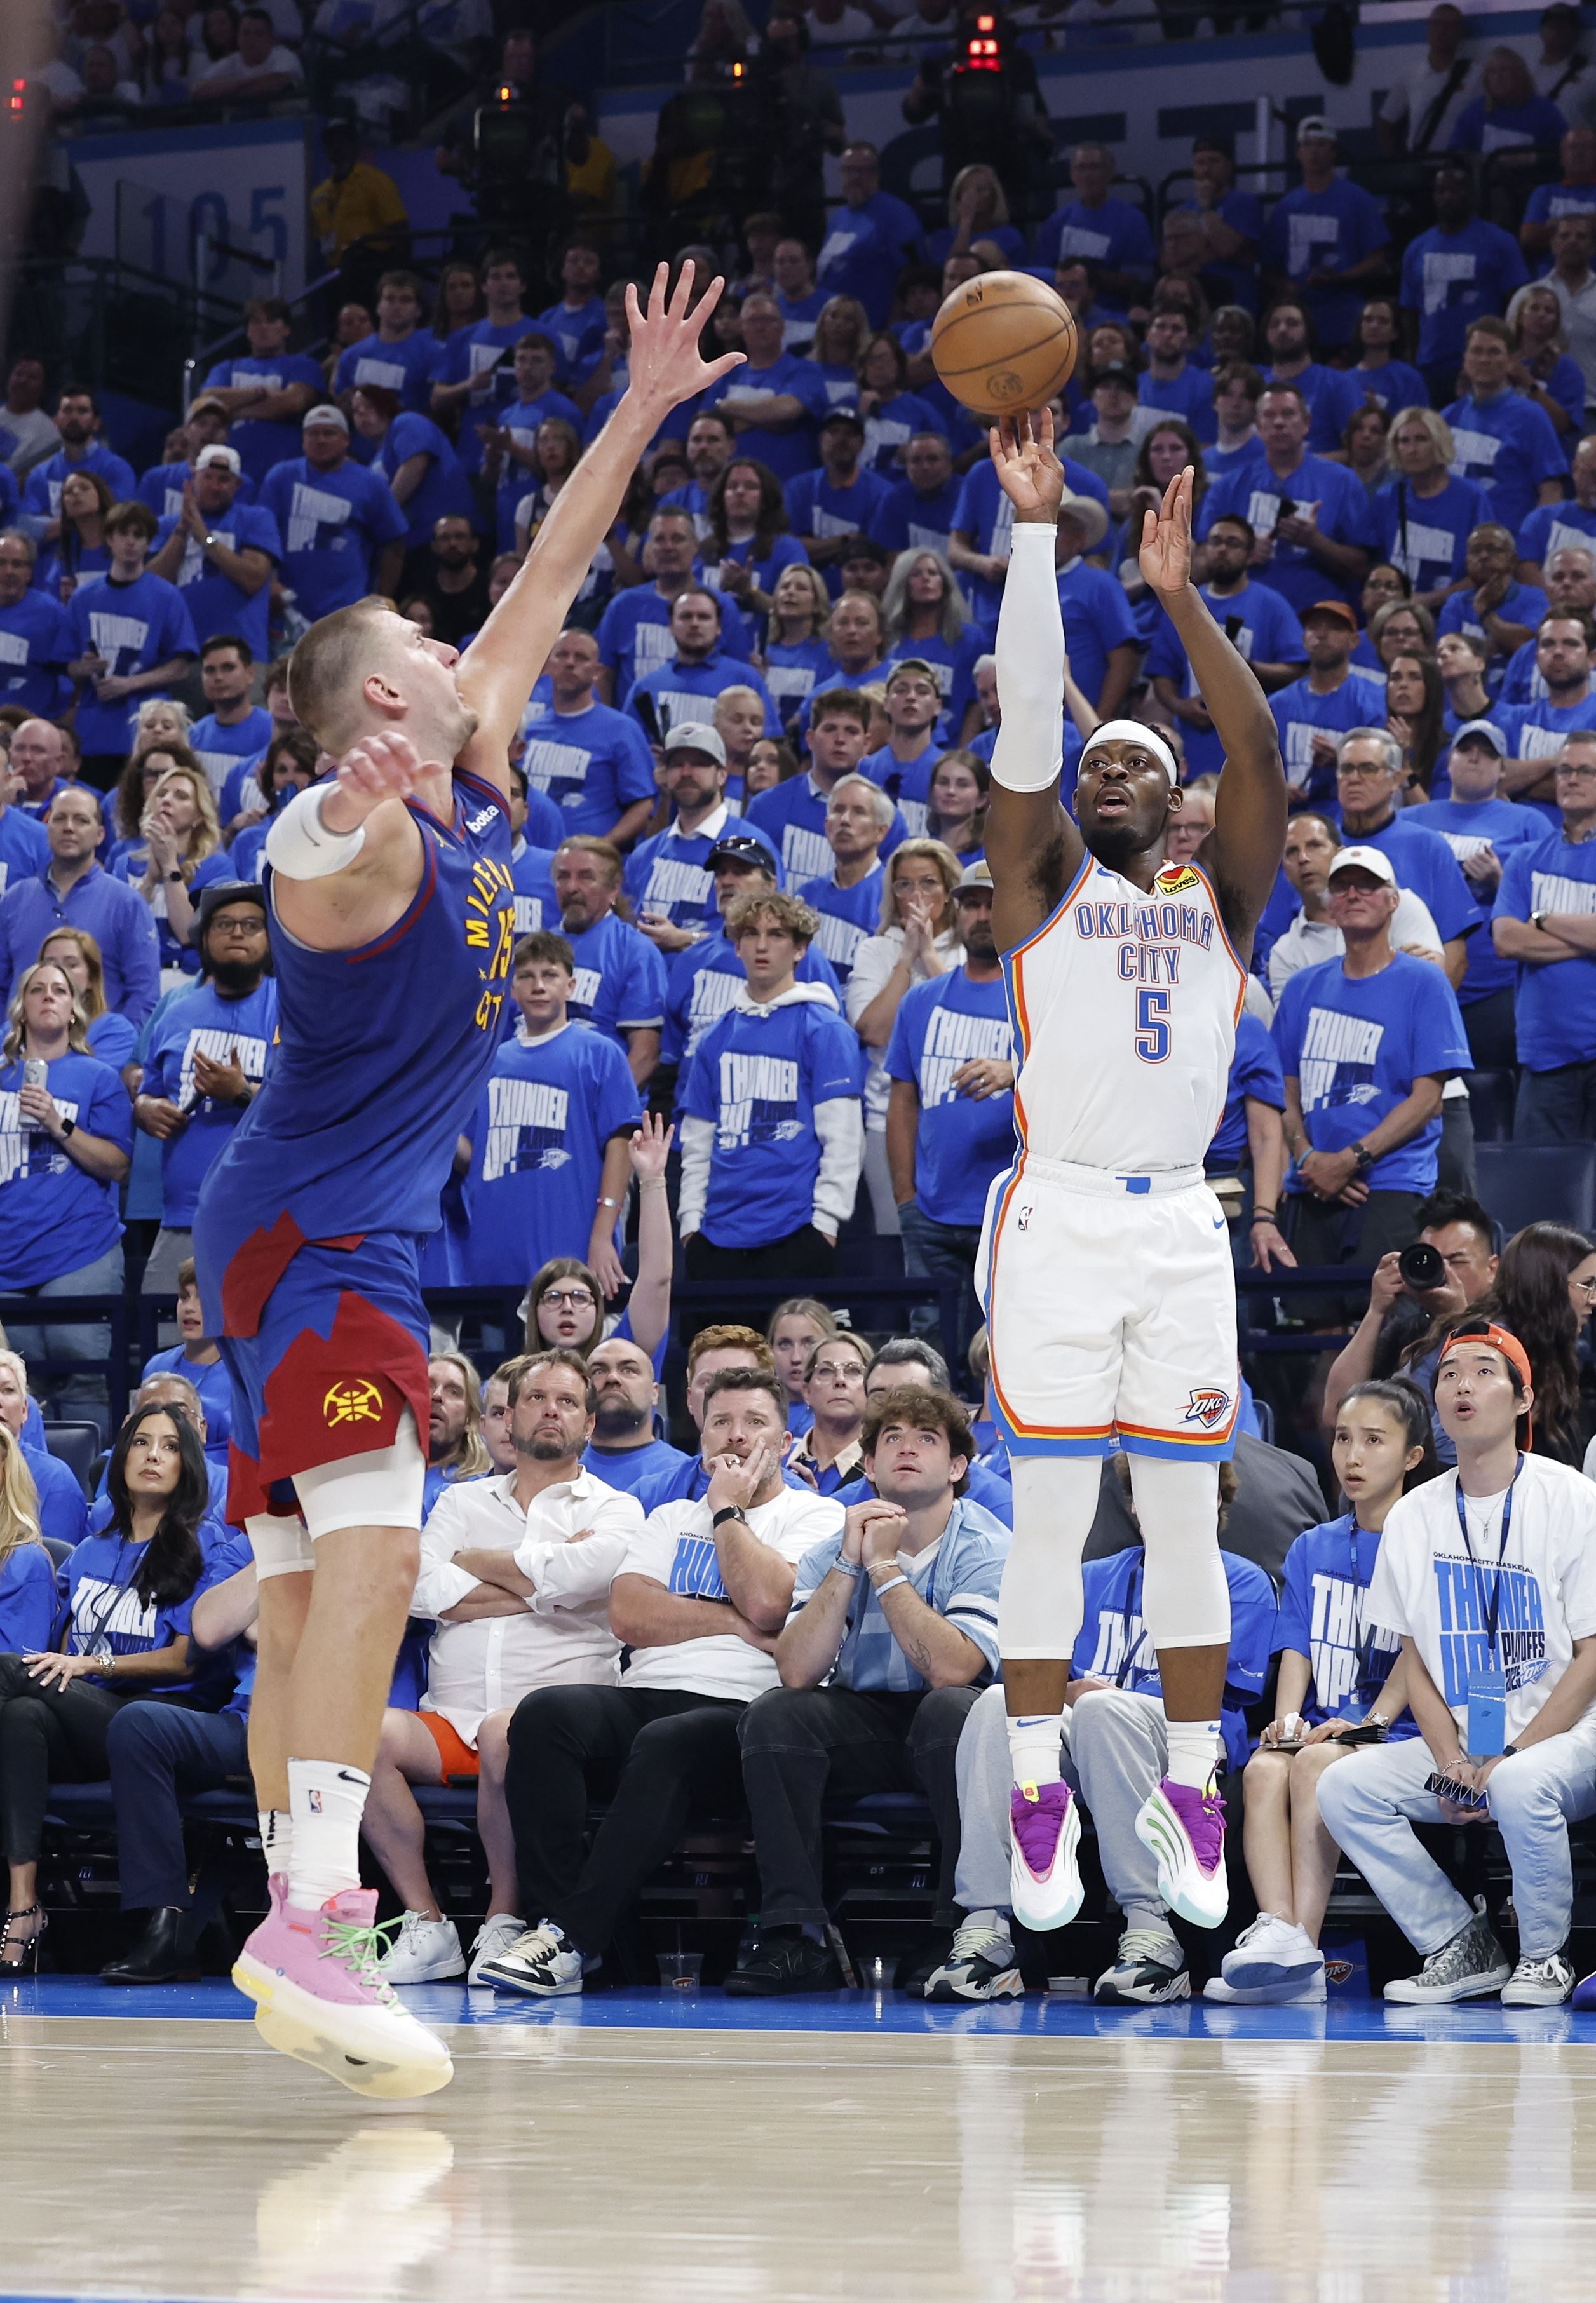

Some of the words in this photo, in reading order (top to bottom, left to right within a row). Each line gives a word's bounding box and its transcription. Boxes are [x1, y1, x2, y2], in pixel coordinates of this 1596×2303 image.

[1074, 902, 1214, 951] OKLAHOMA
[1117, 942, 1180, 984] CITY
[923, 1005, 1010, 1061] THUNDER
[1134, 987, 1171, 1064] 5
[1302, 1006, 1384, 1065] THUNDER
[487, 1077, 569, 1131] THUNDER
[719, 1051, 798, 1104] THUNDER
[1299, 1058, 1337, 1115] UP!
[482, 1126, 520, 1182] UP!
[1433, 1551, 1477, 1564] OKLAHOMA
[1478, 1558, 1494, 1567] CITY
